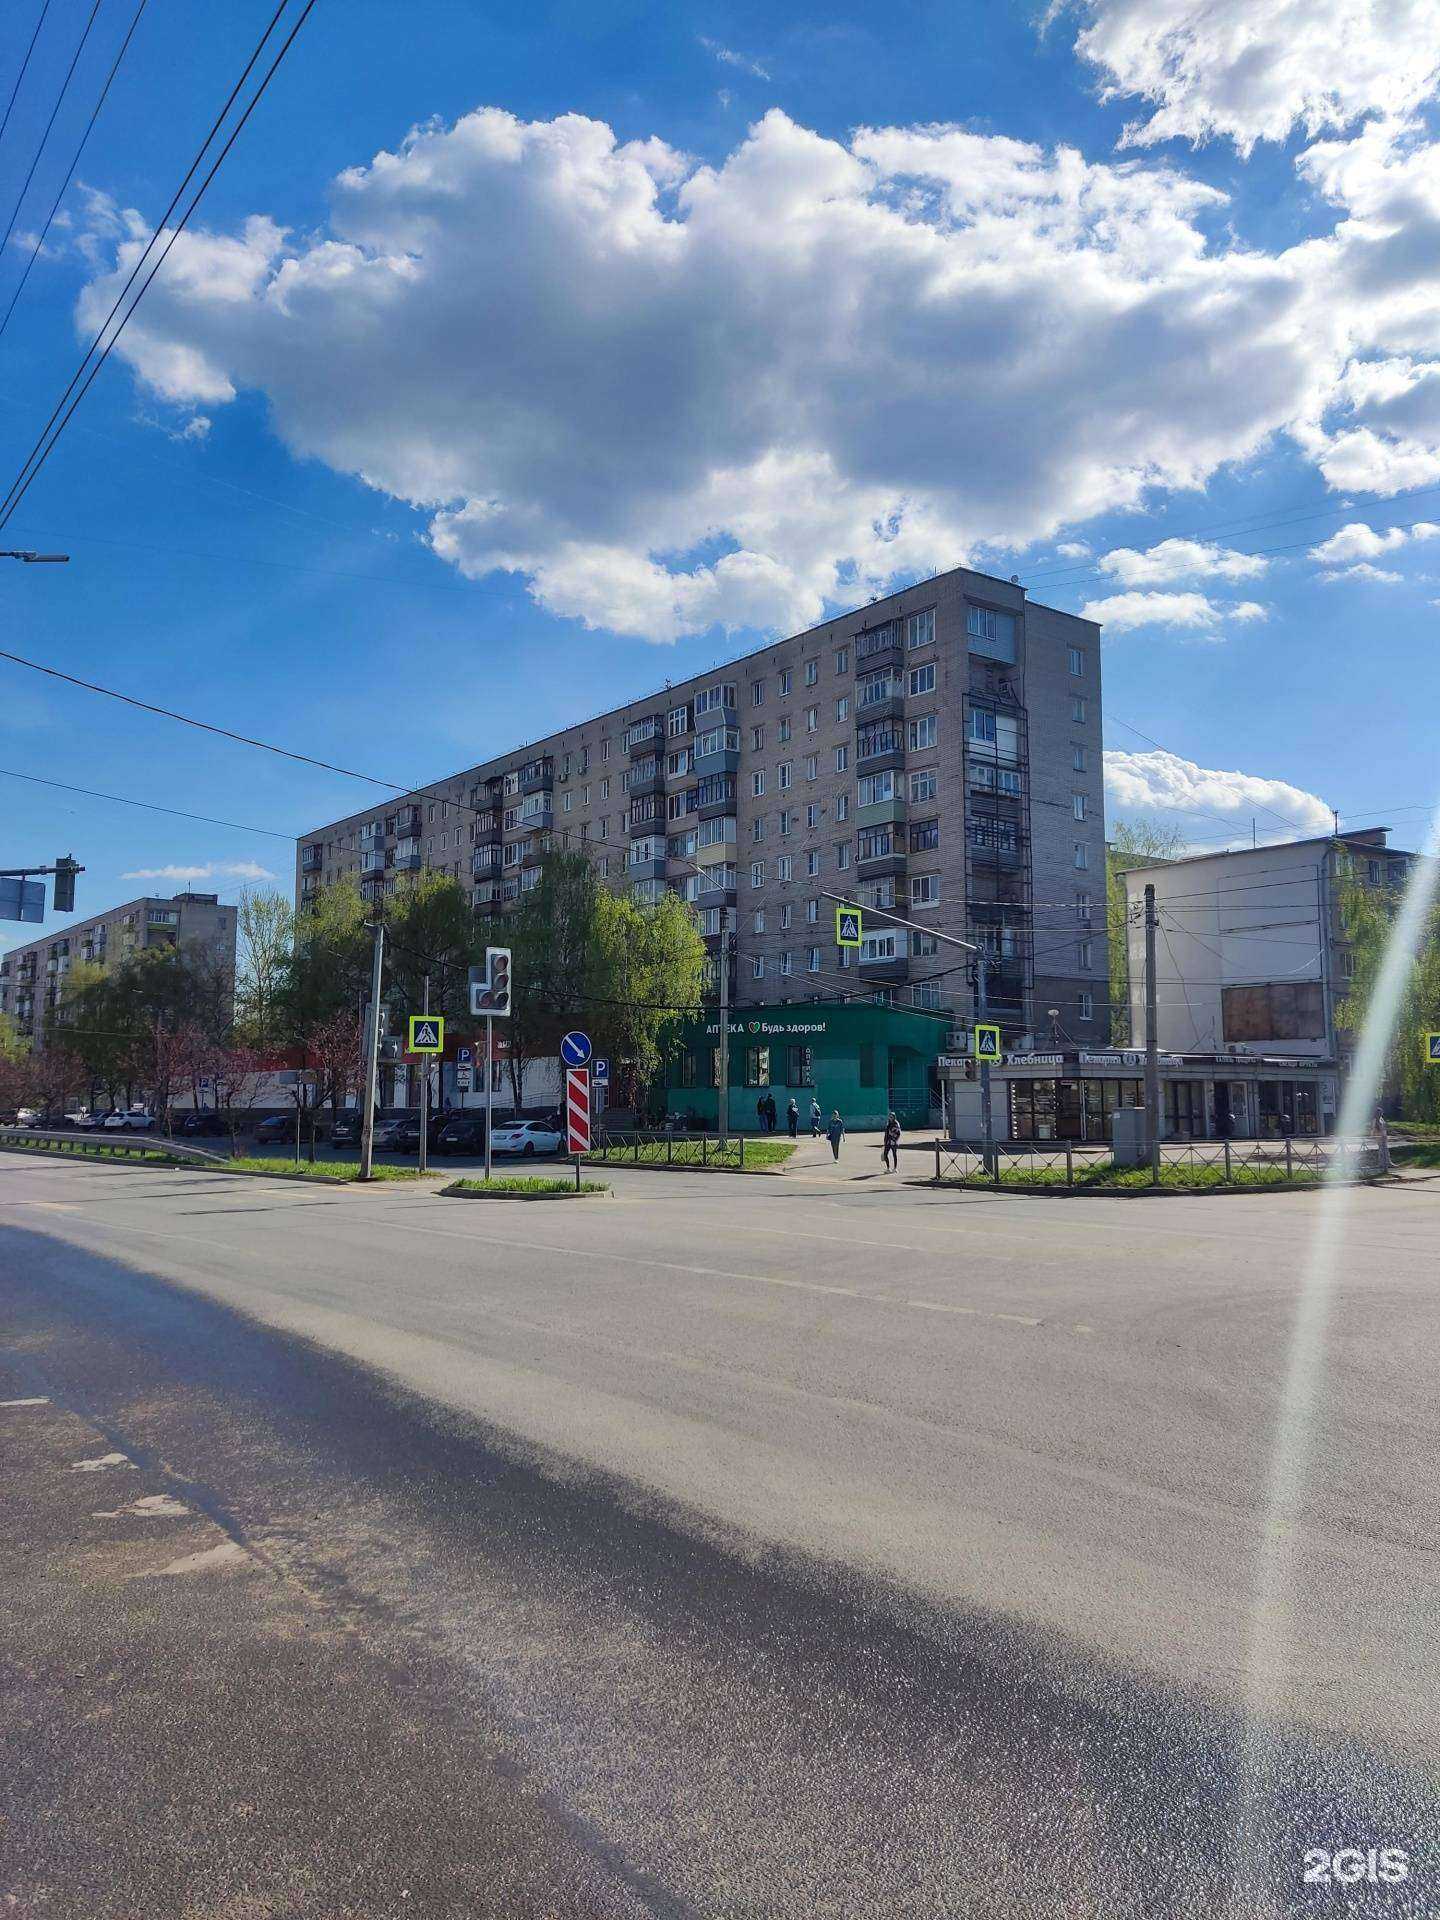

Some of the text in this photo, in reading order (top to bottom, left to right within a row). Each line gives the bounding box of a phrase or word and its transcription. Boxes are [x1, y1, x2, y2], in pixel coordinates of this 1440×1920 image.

[762, 1022, 785, 1034] Будь
[787, 1022, 826, 1034] здоров!
[1006, 1053, 1064, 1066] Хлебница
[596, 1062, 605, 1076] P
